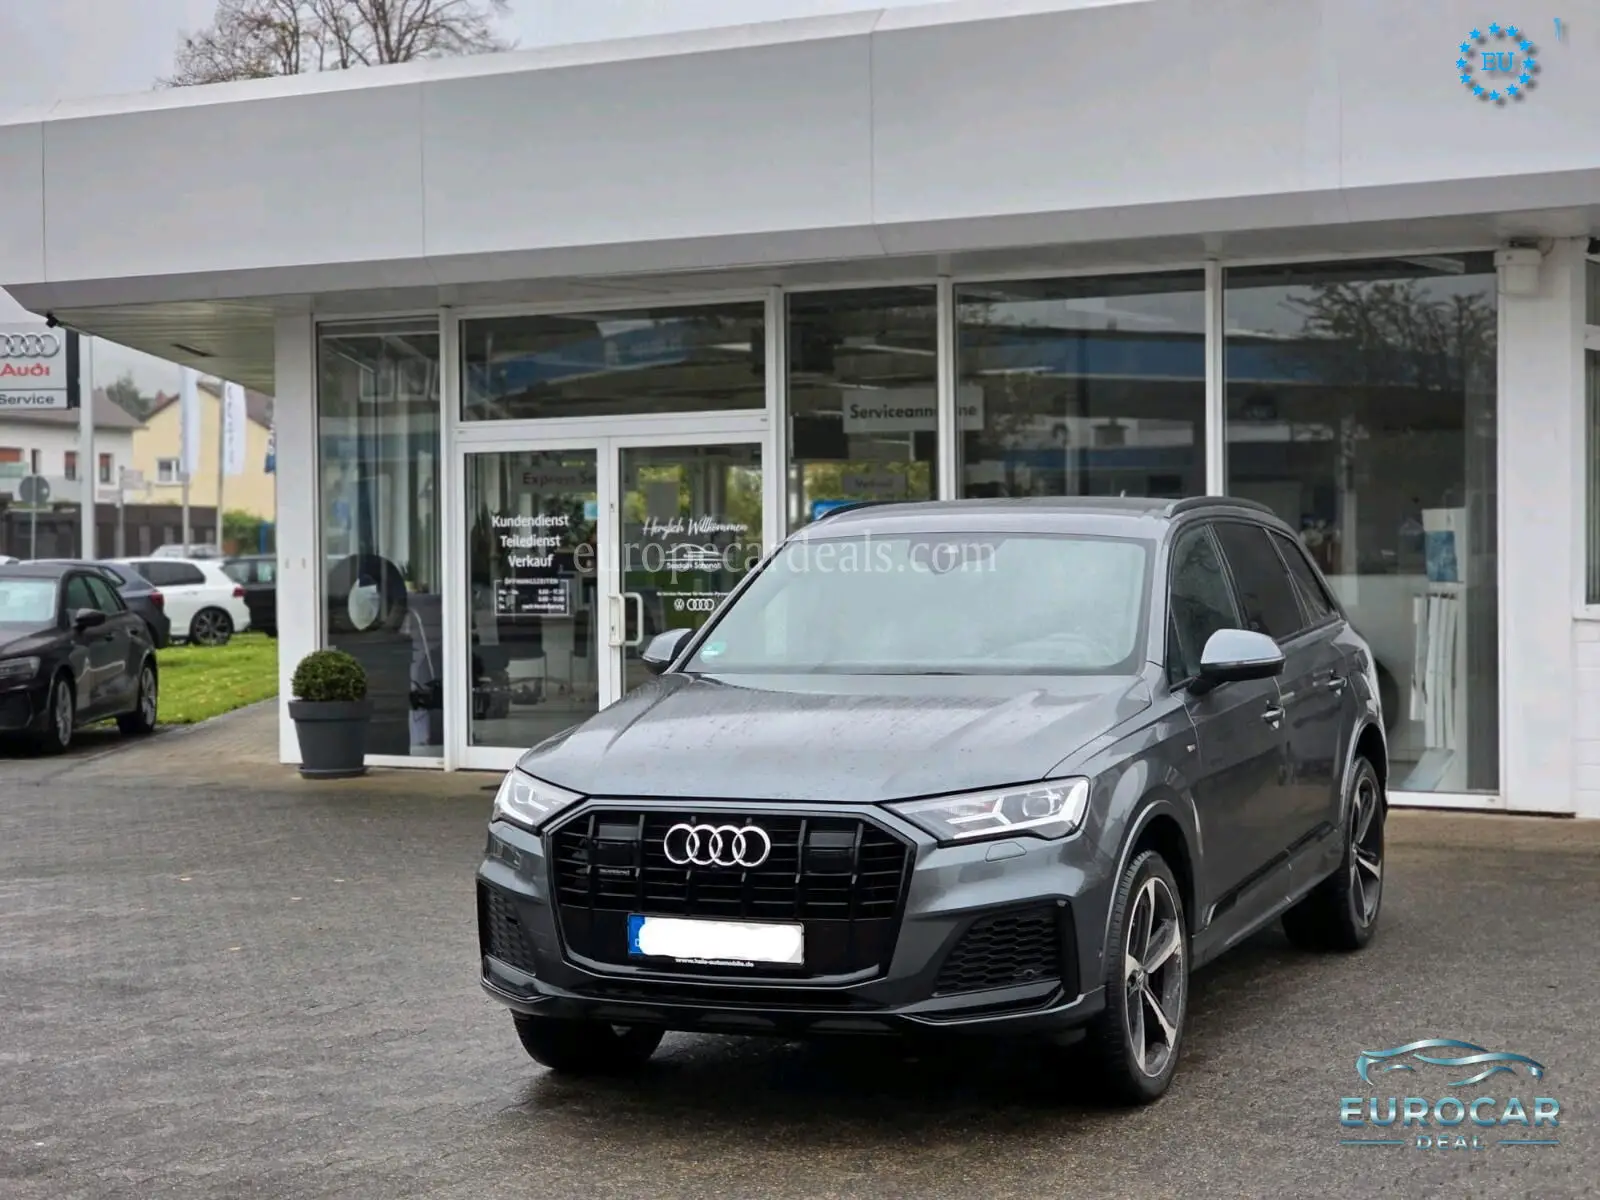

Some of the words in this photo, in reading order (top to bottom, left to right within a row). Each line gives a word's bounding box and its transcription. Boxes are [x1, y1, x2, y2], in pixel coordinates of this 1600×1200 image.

[0, 363, 50, 376] Audi
[0, 392, 55, 405] Service
[491, 514, 569, 528] Kundendienst
[687, 514, 749, 535] Willkommen
[500, 535, 561, 548] Teiledienst
[508, 554, 554, 567] Verkauf
